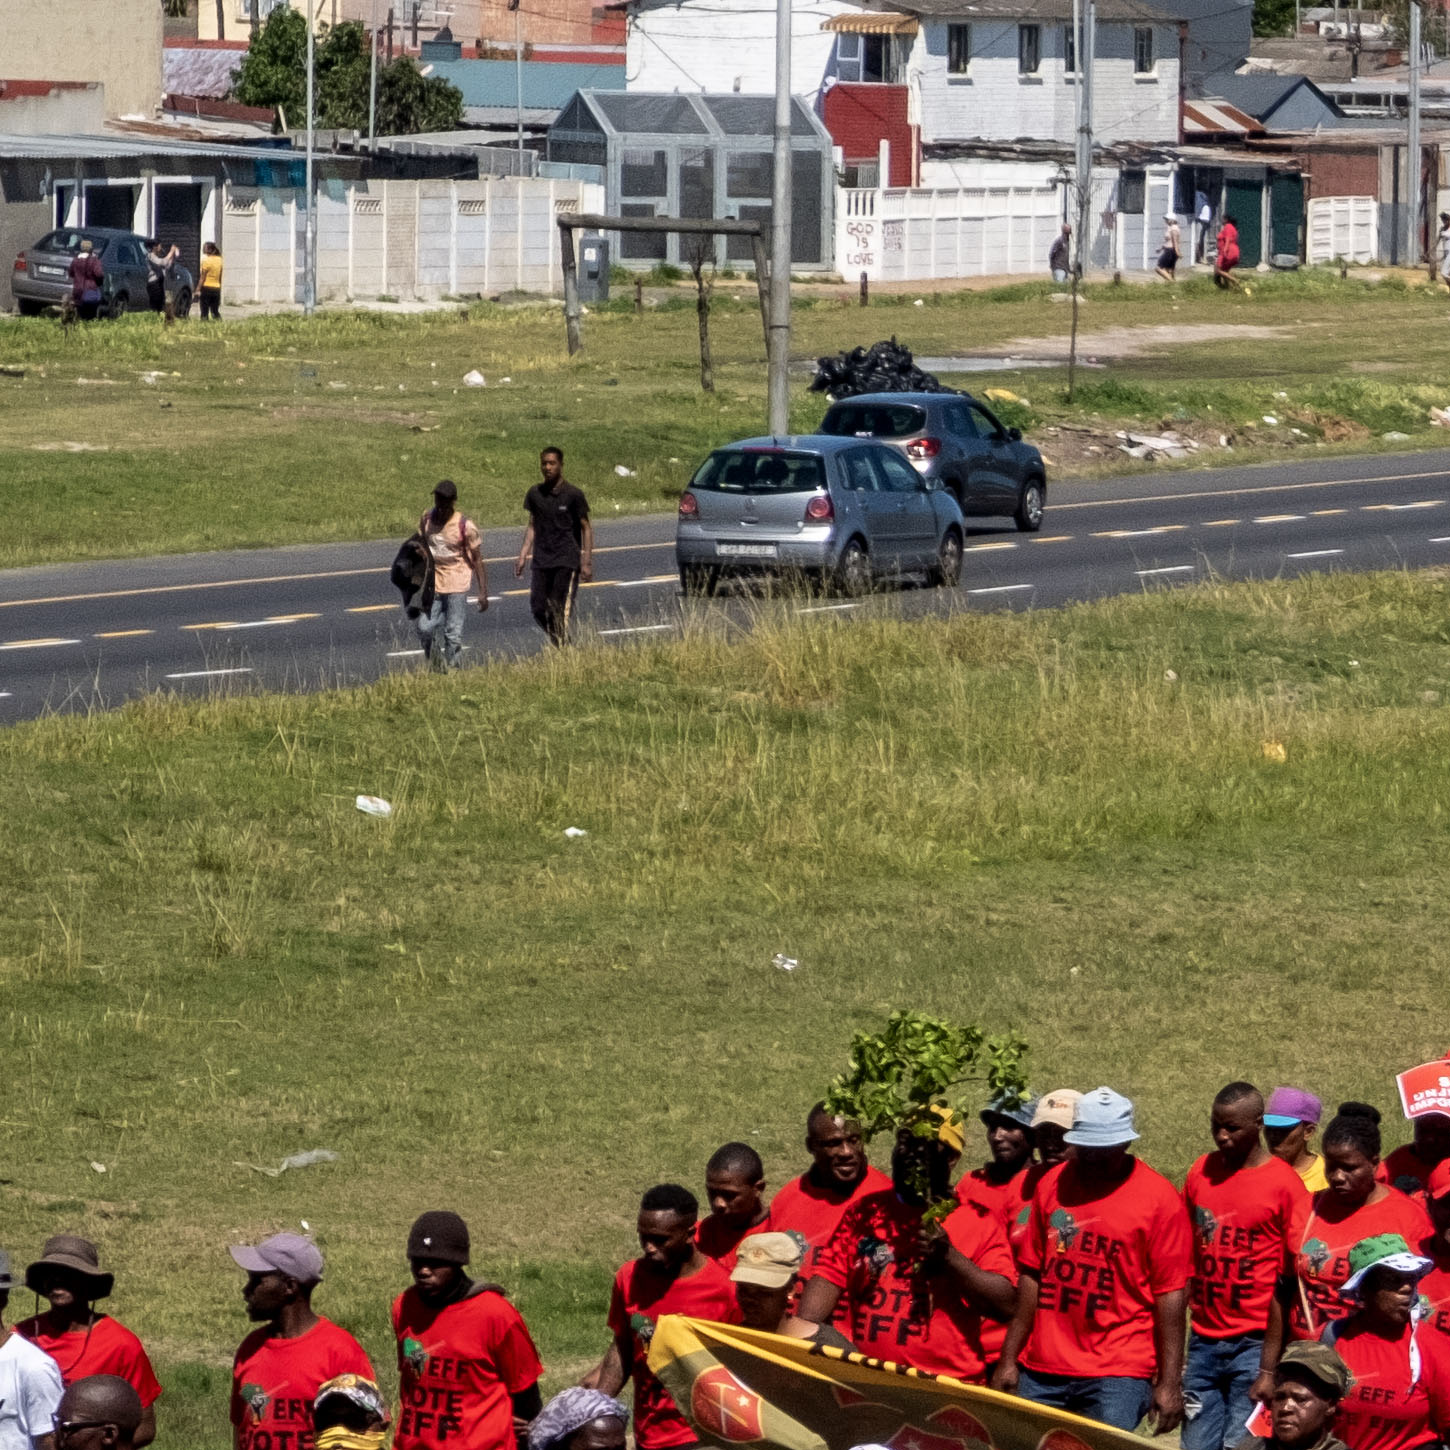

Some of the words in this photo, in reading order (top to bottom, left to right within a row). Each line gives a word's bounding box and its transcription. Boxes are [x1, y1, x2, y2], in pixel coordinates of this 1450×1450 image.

[846, 222, 874, 235] GOD
[846, 253, 874, 265] LOVE
[1080, 1231, 1120, 1257] EFF
[1220, 1226, 1260, 1250] EFF
[1040, 1258, 1114, 1290] VOTE
[1038, 1281, 1108, 1321] EFF
[427, 1359, 471, 1380] EFF
